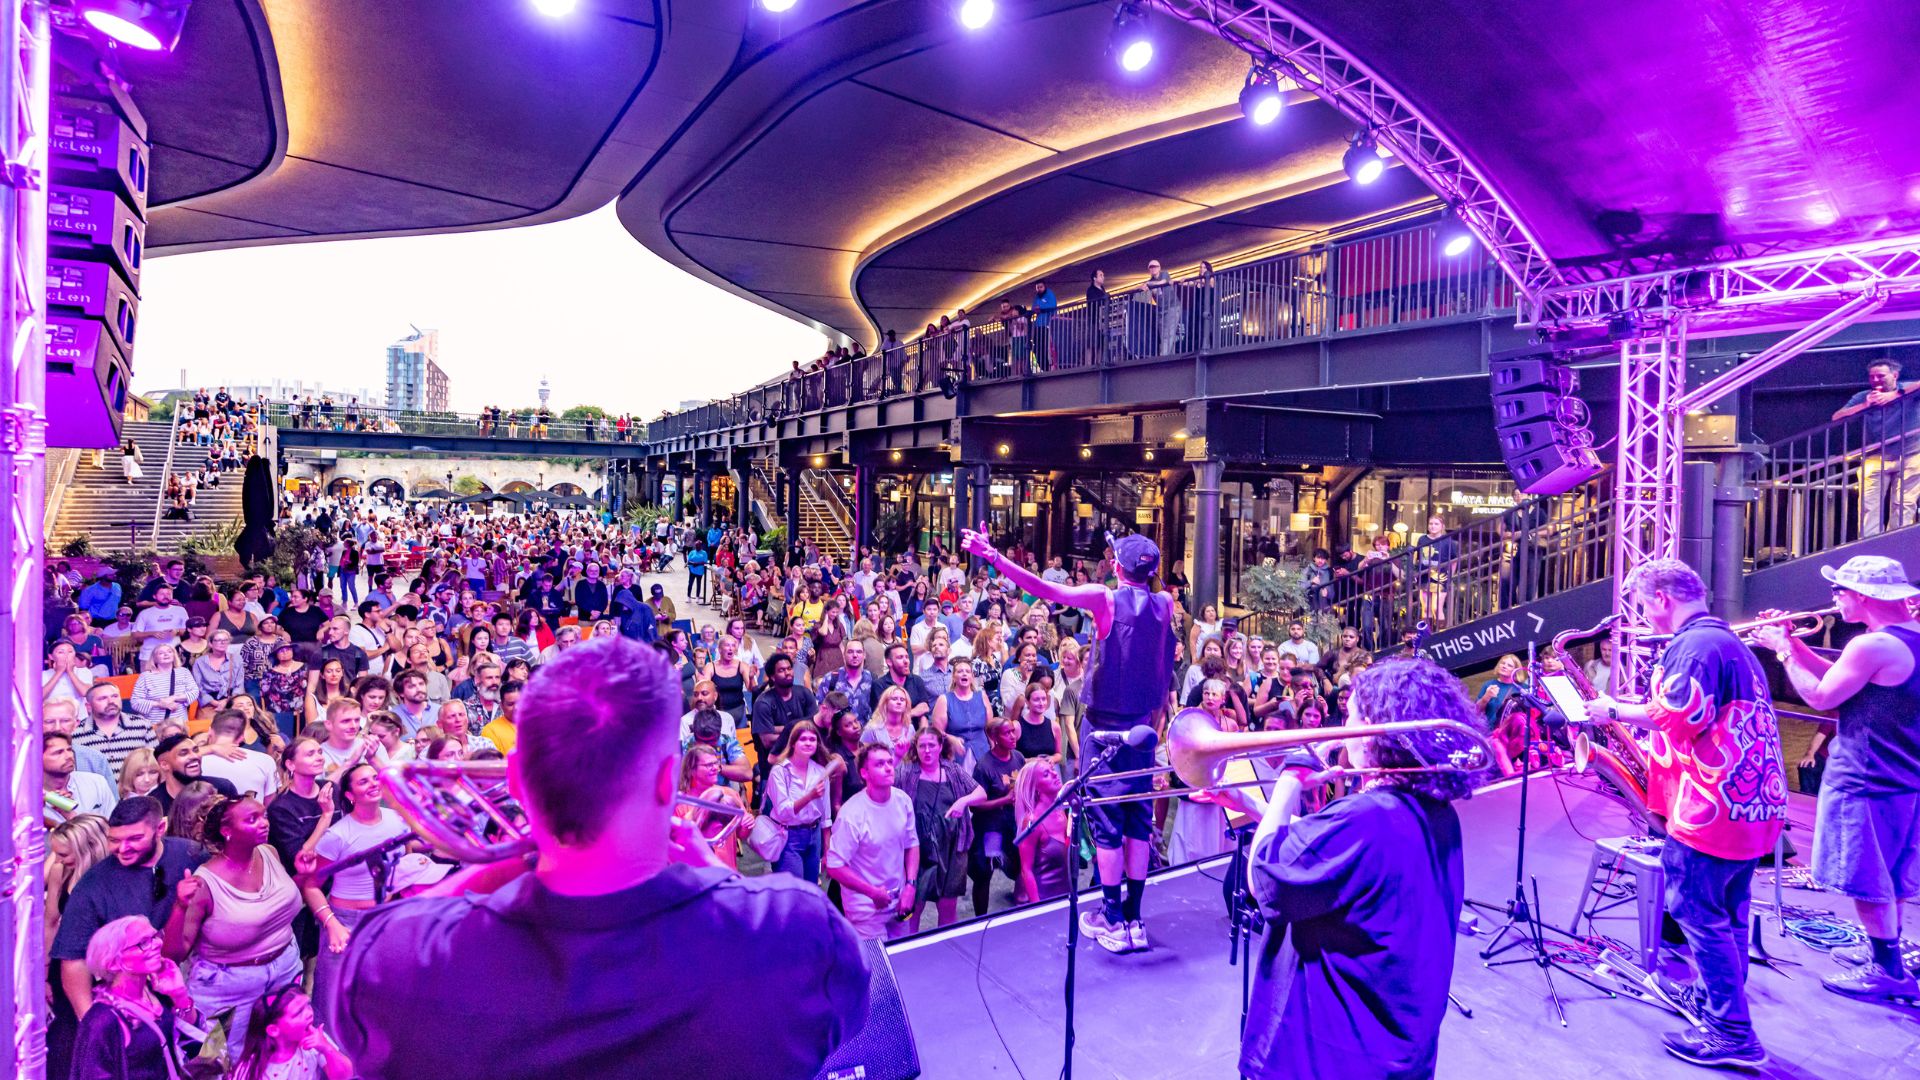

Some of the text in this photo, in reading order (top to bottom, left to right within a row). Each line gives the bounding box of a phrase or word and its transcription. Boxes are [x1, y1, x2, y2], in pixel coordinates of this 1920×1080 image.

[1488, 495, 1515, 506] MAG
[1430, 635, 1474, 660] THIS
[1473, 620, 1516, 647] WAY
